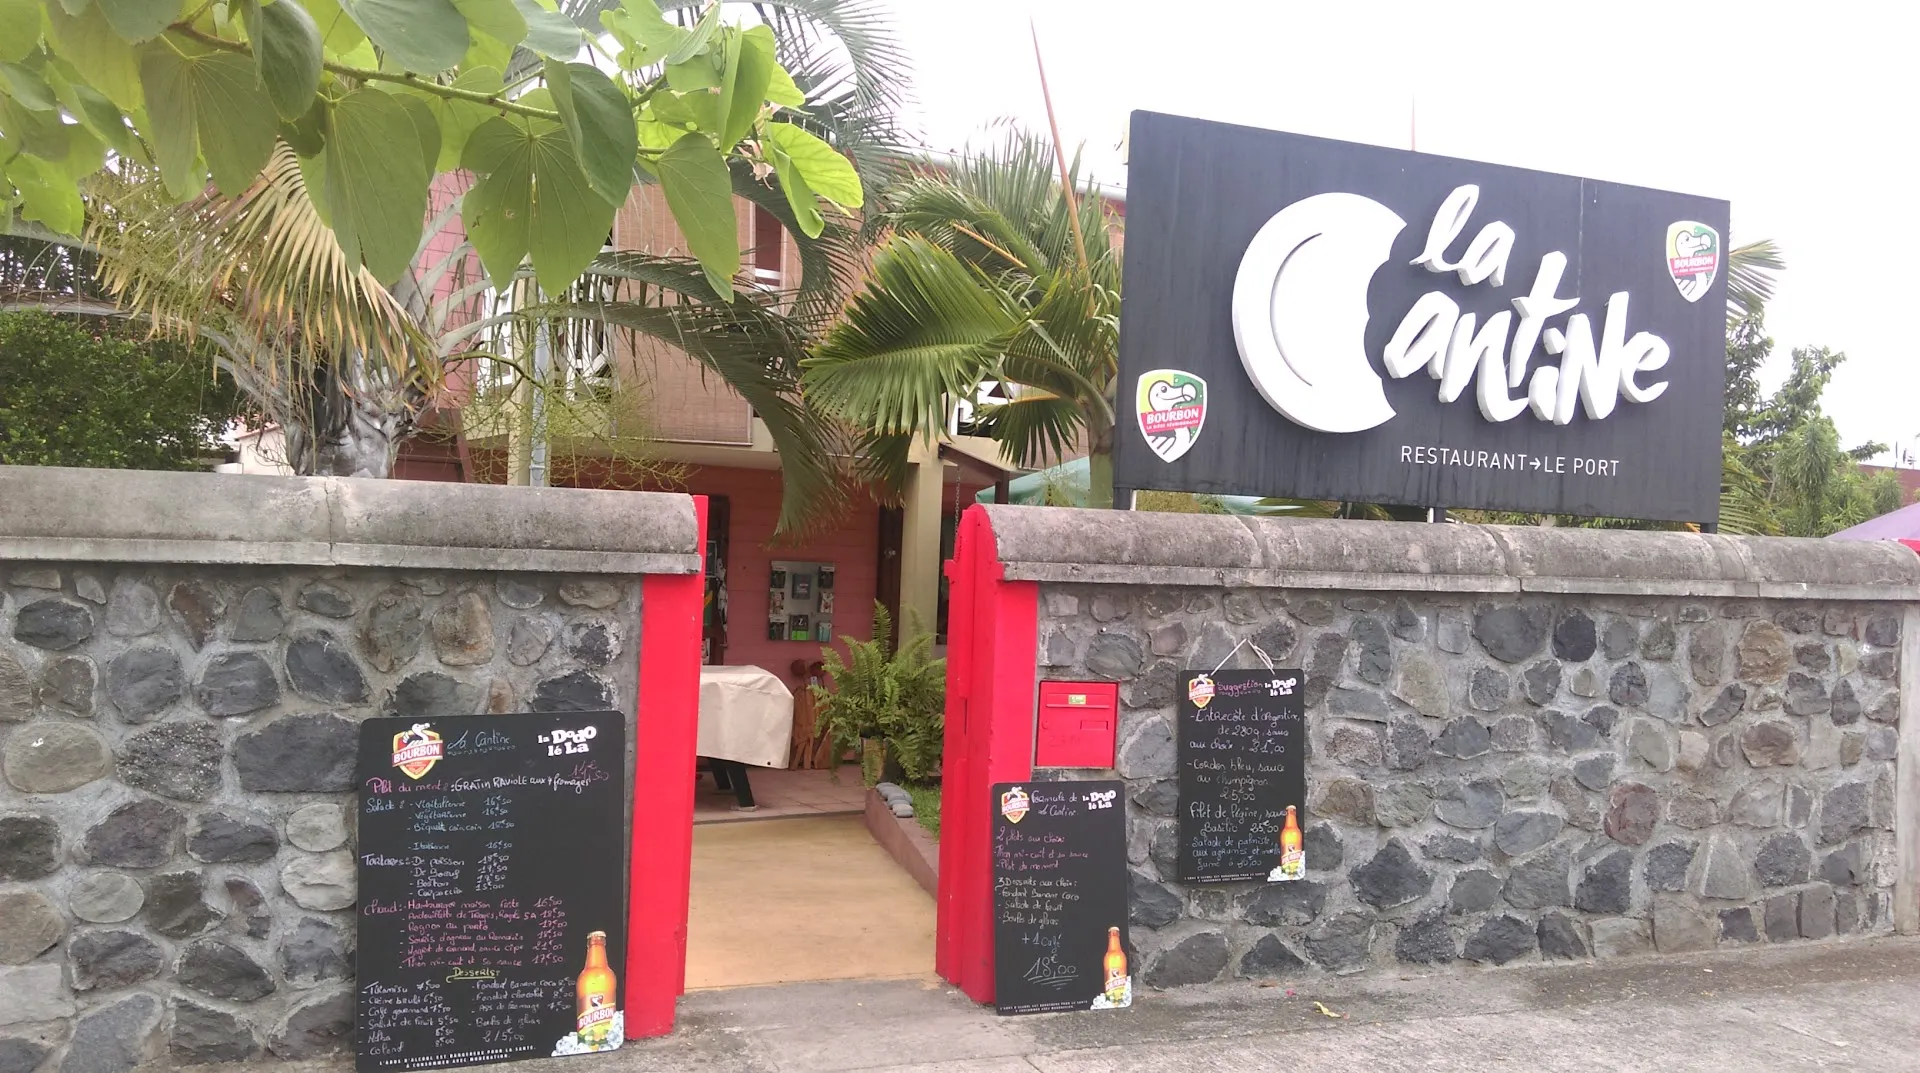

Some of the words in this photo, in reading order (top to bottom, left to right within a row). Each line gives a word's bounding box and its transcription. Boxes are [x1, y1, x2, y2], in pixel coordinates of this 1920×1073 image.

[1409, 185, 1516, 287] la
[1673, 256, 1714, 269] BOURBON
[1146, 408, 1200, 425] BOURBON
[1401, 445, 1528, 471] RESTAURANT
[1544, 456, 1566, 474] LE
[1573, 457, 1620, 477] PORT
[538, 735, 550, 744] la
[550, 725, 597, 745] Dodo
[393, 744, 440, 764] BOURBON
[547, 745, 562, 757] lé
[564, 742, 590, 755] La
[578, 1005, 615, 1029] BOURBON
